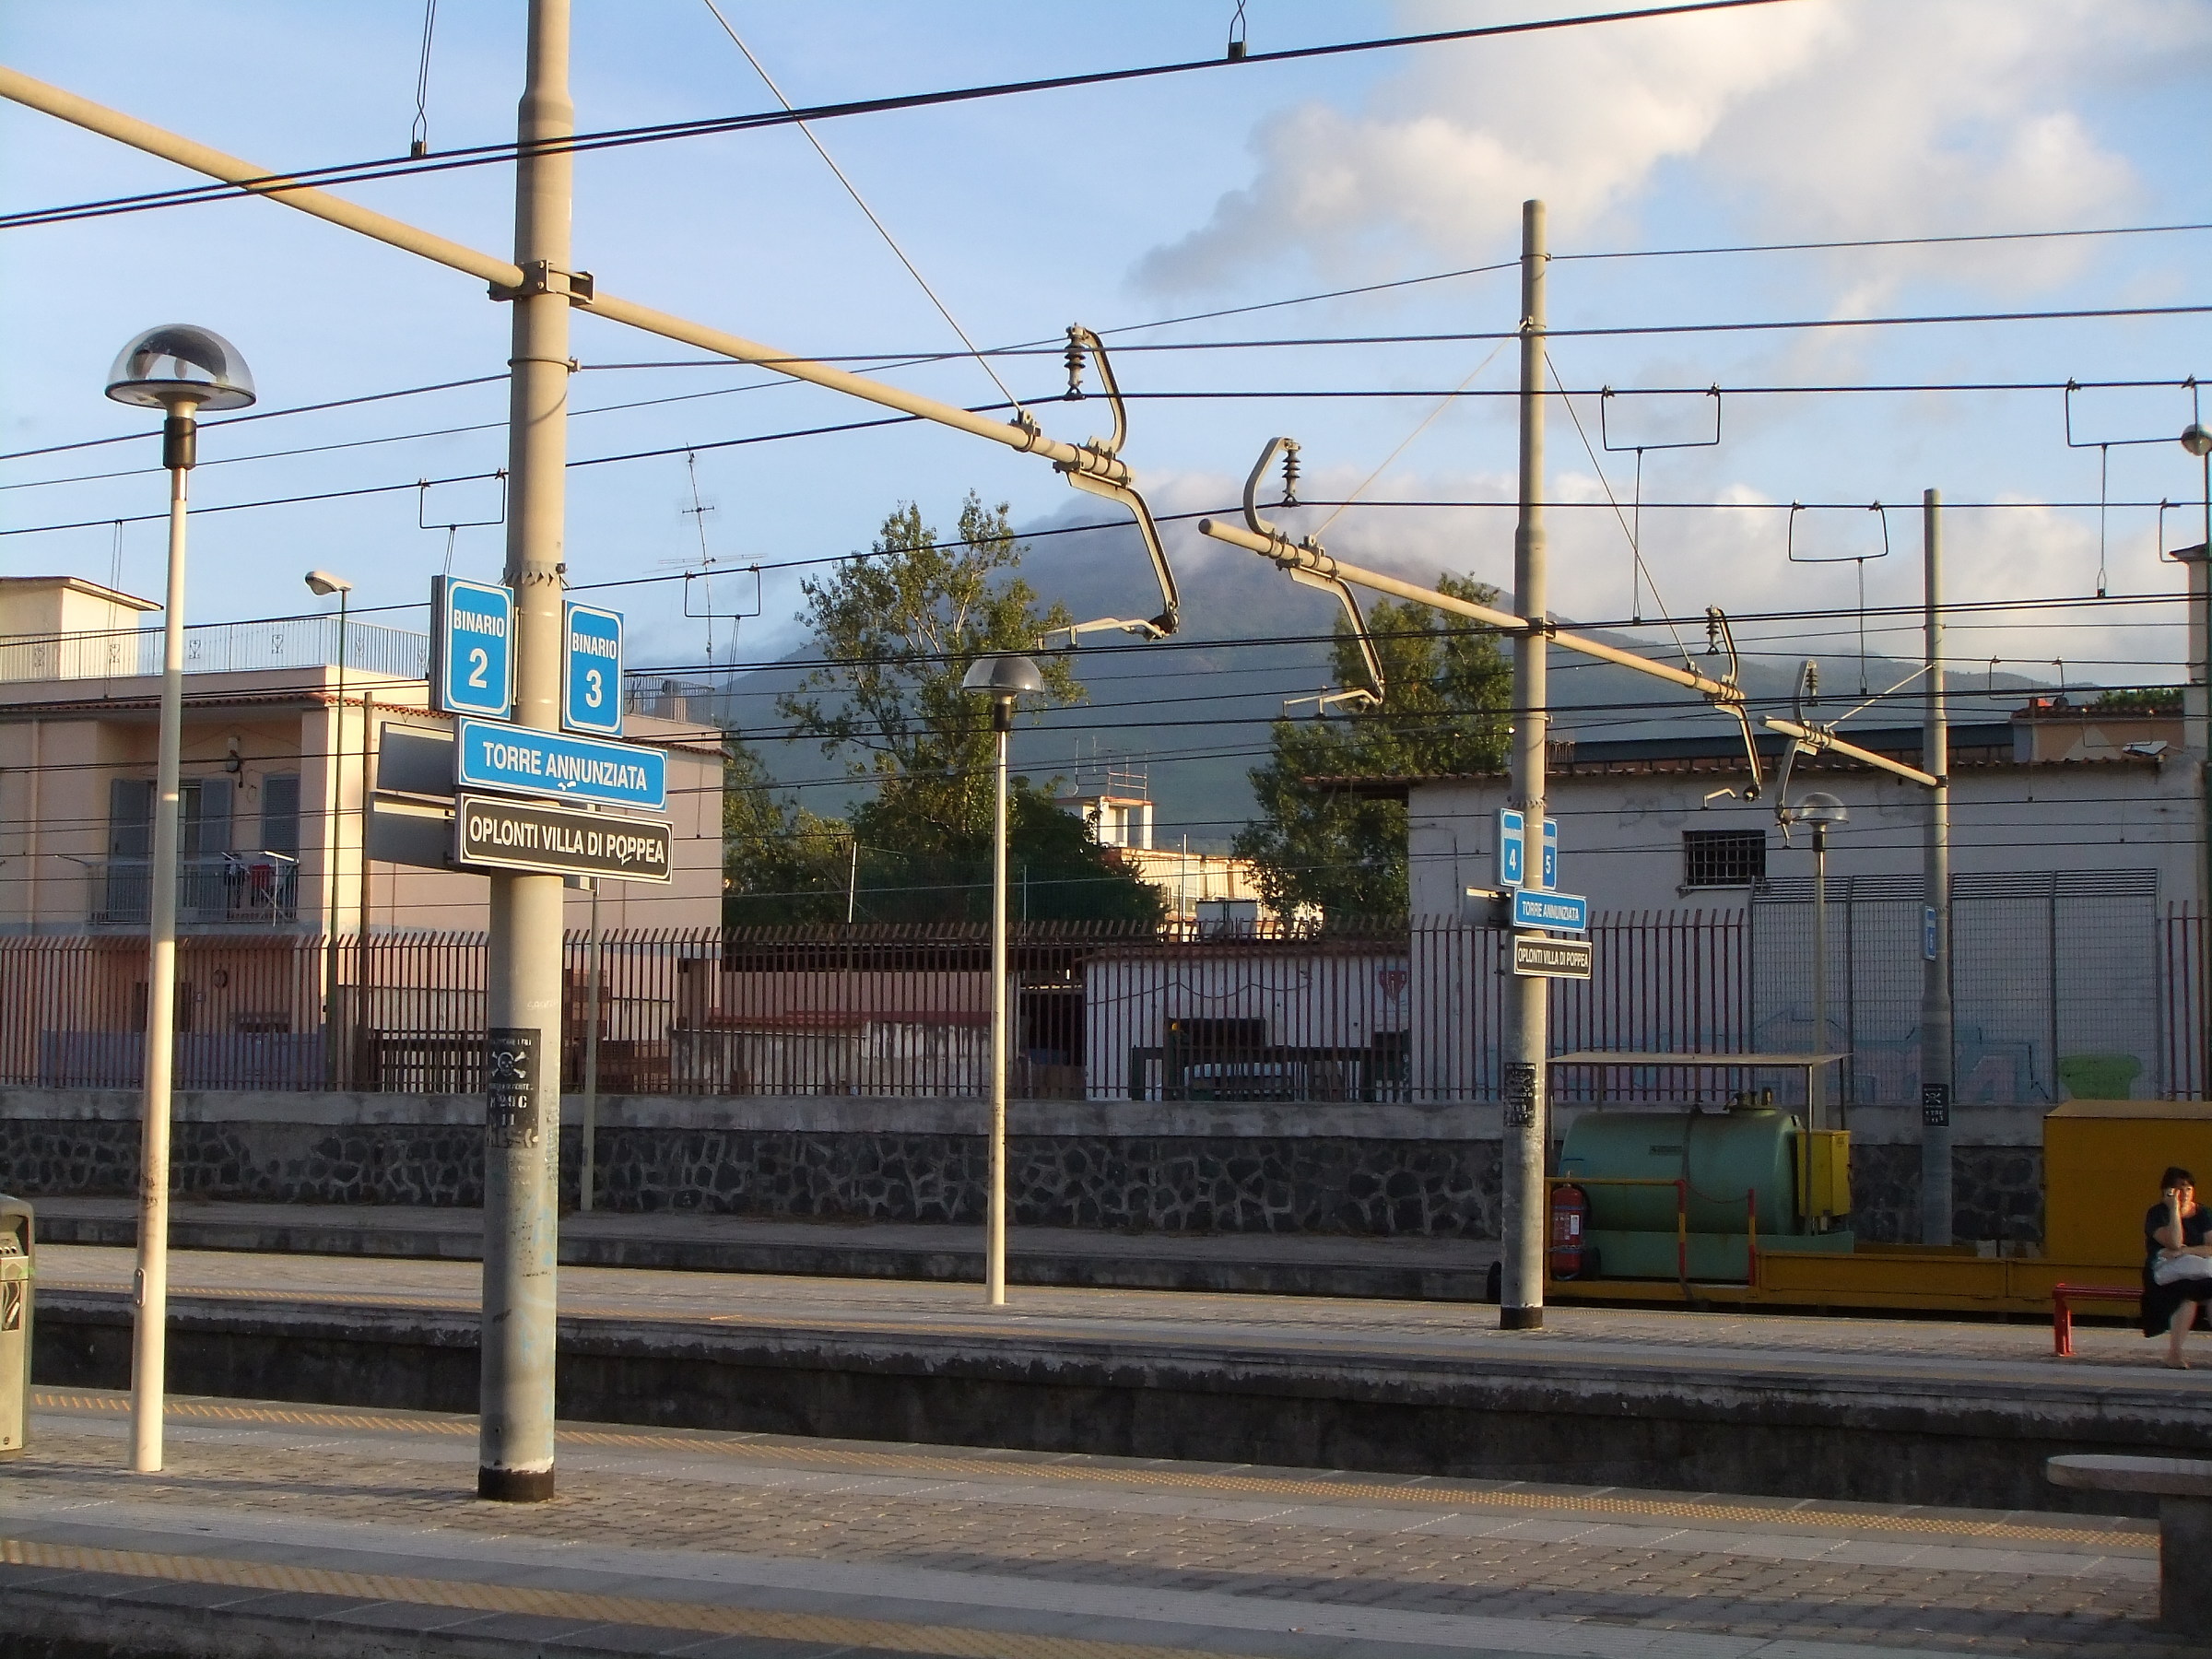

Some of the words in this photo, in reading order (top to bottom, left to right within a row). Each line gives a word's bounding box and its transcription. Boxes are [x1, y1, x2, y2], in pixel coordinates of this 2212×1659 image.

[453, 608, 505, 638] BINARIO
[571, 631, 617, 660] BINARIO
[468, 648, 488, 688] 2
[585, 669, 603, 708] 3
[483, 741, 542, 775] TORRE
[545, 752, 647, 791] ANNUNZIATA
[469, 816, 538, 849] OPLONTI
[542, 826, 584, 855] VILLA
[587, 832, 603, 857] DI
[606, 835, 665, 865] POPPEA
[1509, 848, 1516, 871] 4
[1545, 855, 1552, 874] 5
[1522, 900, 1543, 917] TORRE
[1543, 904, 1580, 922] ANNUNZIATA
[1517, 947, 1542, 963] OPLONTI
[1543, 949, 1559, 965] VILLA
[1559, 951, 1566, 966] DI
[1566, 951, 1589, 968] POPPEA
